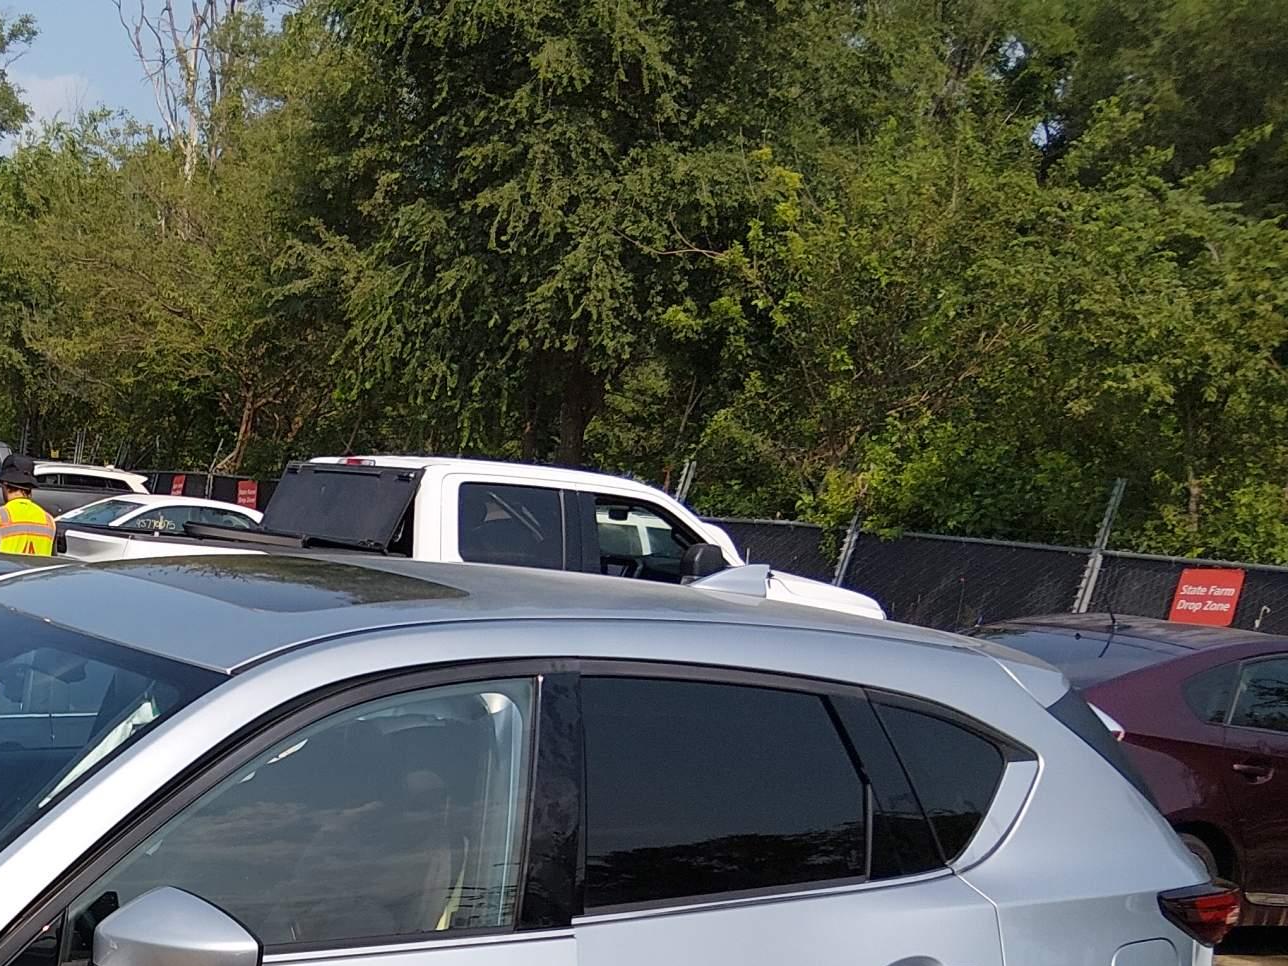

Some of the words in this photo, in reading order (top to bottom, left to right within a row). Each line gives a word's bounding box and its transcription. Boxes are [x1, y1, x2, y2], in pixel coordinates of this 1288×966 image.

[1180, 584, 1207, 596] State
[1208, 585, 1235, 597] Farm
[1176, 600, 1202, 612] Drop
[1203, 600, 1230, 612] Zone
